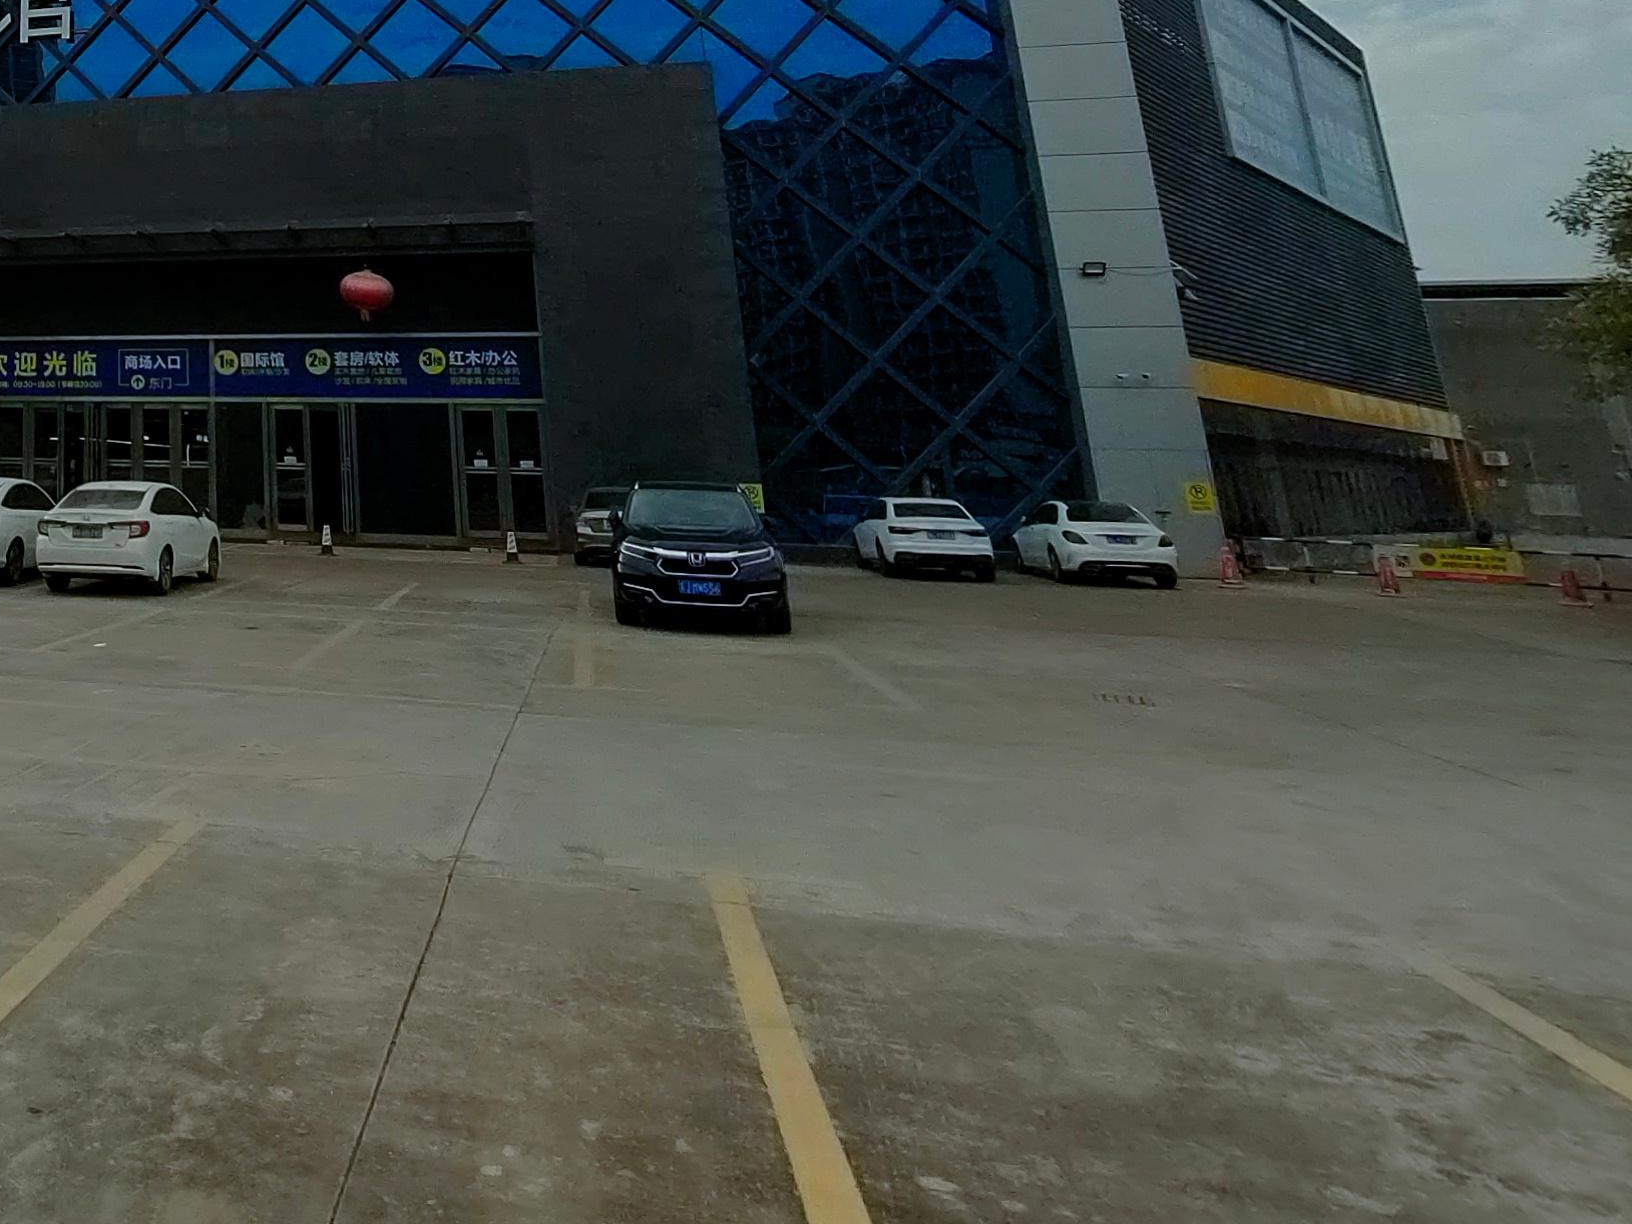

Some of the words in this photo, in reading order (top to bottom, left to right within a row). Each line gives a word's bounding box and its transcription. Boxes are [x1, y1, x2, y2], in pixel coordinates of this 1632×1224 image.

[123, 354, 182, 371] 商场入口
[240, 351, 286, 369] 国际馆
[333, 350, 400, 367] 套房/软体
[448, 350, 519, 367] 红木/办公
[147, 377, 173, 391] 东门
